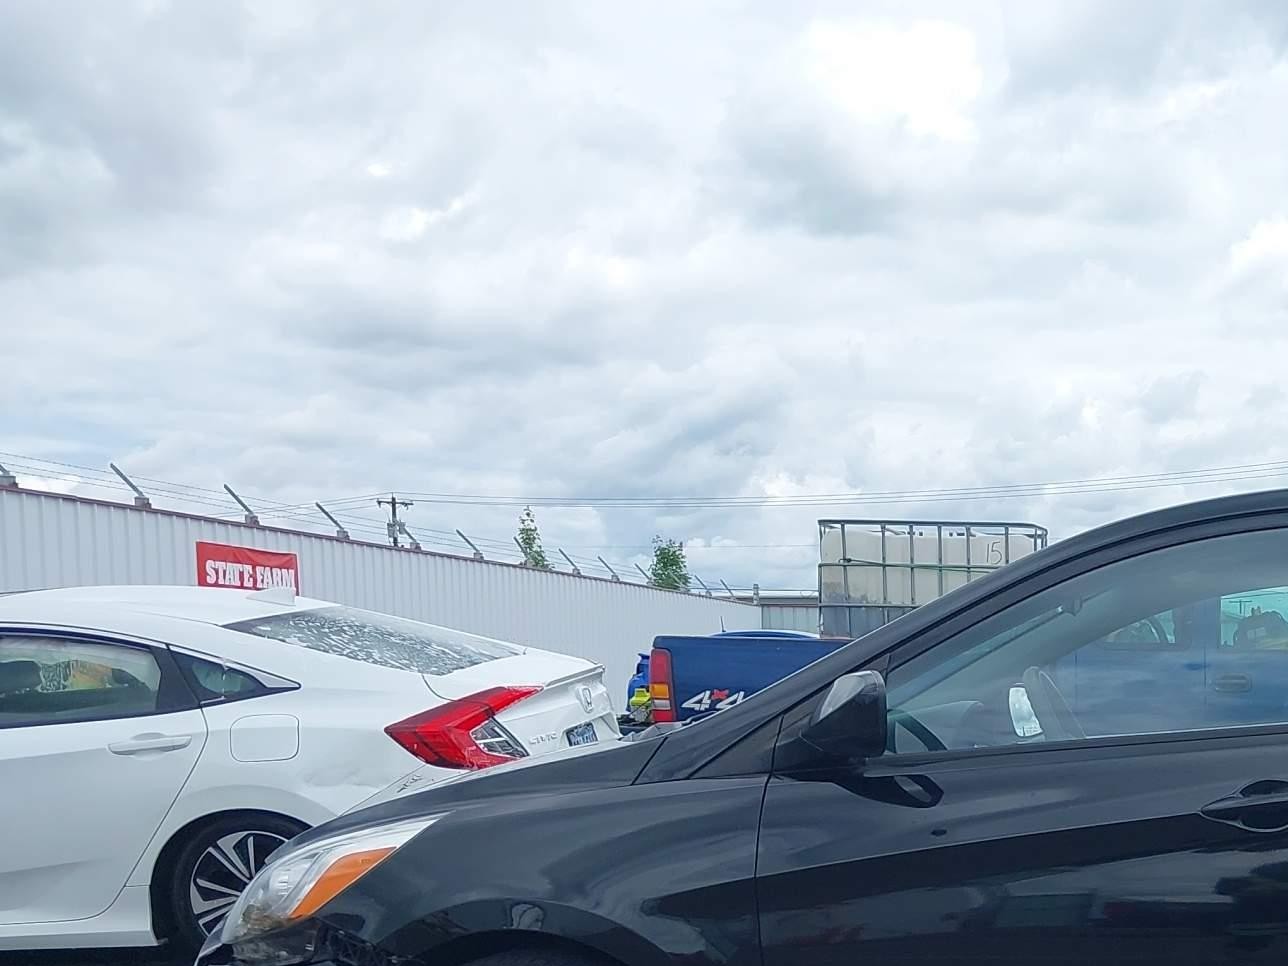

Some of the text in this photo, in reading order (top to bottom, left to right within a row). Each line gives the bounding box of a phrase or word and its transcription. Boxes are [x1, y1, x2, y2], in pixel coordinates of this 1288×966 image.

[986, 541, 1003, 565] 15
[205, 560, 296, 590] STATE FARM
